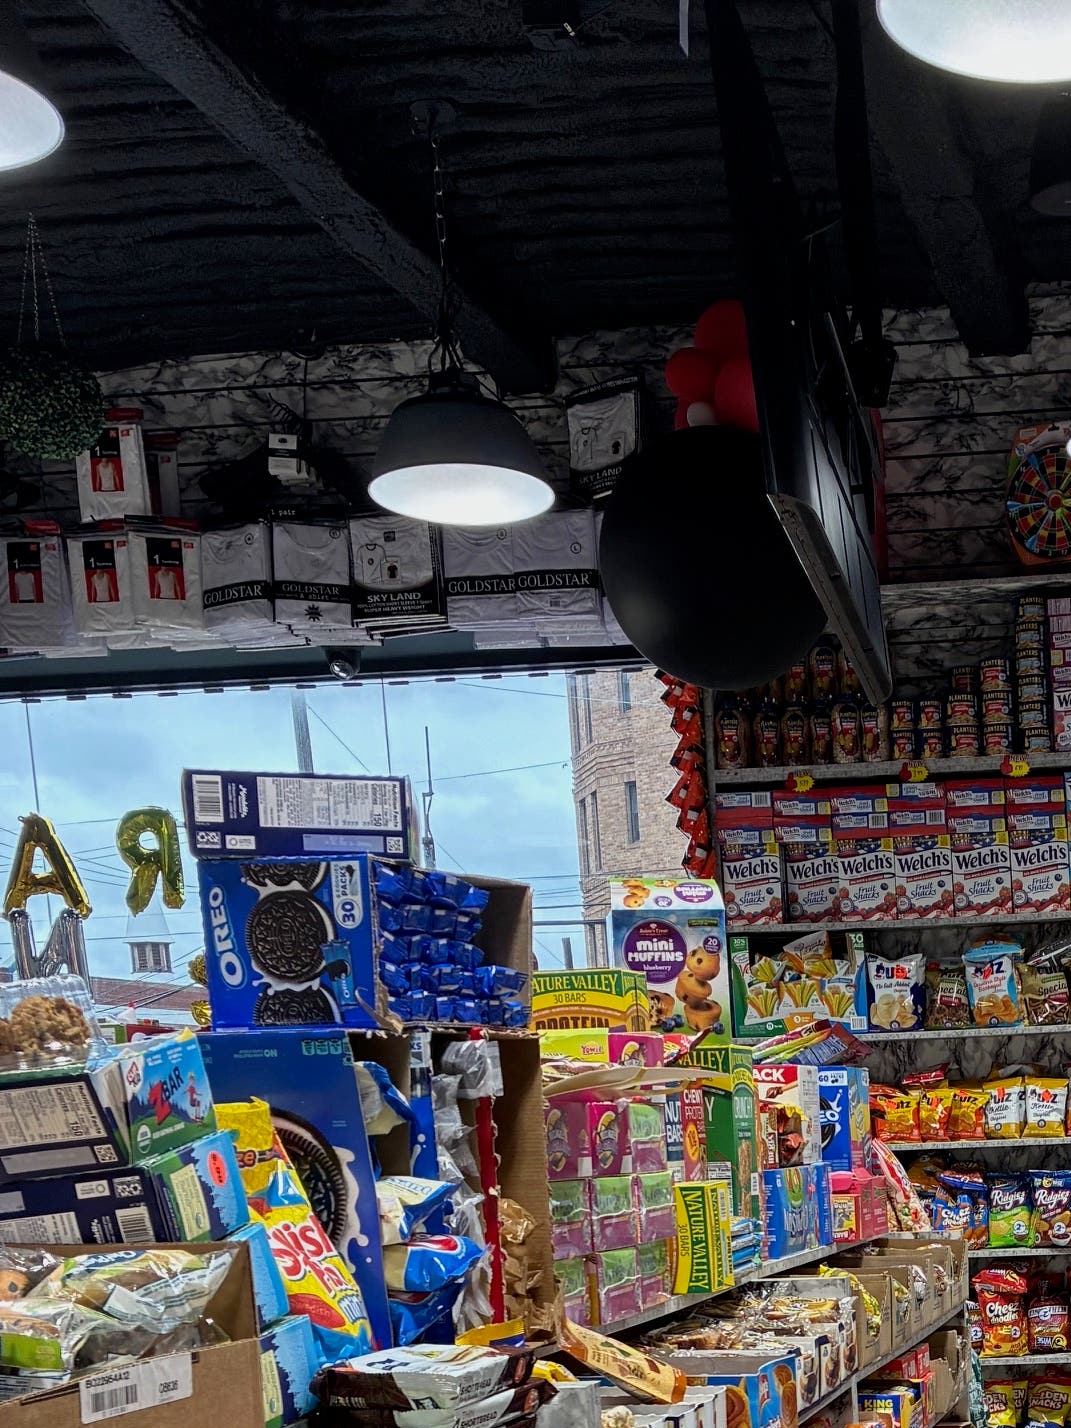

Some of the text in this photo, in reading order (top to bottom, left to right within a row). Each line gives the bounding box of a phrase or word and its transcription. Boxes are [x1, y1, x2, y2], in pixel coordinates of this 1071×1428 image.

[449, 578, 515, 593] GOLDSTAR
[518, 572, 590, 588] GOLDSTAR
[204, 585, 262, 605] GOLDSTAR
[282, 583, 339, 596] GOLDSTAR
[367, 592, 421, 603] SKY LAND
[953, 726, 978, 735] PLANTERS
[897, 850, 950, 873] Welch's
[955, 848, 1008, 871] Welch's
[1014, 844, 1067, 868] Welch's
[726, 859, 778, 880] Welch's
[839, 854, 893, 876] Welch's
[915, 882, 933, 893] Fruit
[973, 878, 991, 889] Fruit
[744, 888, 762, 899] Fruit
[807, 888, 825, 899] Fruit
[853, 892, 880, 902] Snacks
[858, 885, 876, 896] Fruit
[910, 889, 937, 900] Snacks
[968, 885, 995, 896] Snacks
[740, 896, 766, 906] Snacks
[802, 896, 828, 906] Snacks
[342, 901, 355, 923] 30
[209, 886, 243, 987] OREO
[636, 938, 674, 951] mini
[628, 951, 684, 962] MUFFINS
[572, 974, 618, 991] VALLEY
[554, 993, 586, 1003] 30 BARS
[162, 1066, 184, 1100] BAR
[1036, 1189, 1070, 1204] Ridgies
[683, 1190, 704, 1290] NATURE VALLEY
[987, 1302, 1019, 1317] Cheez
[991, 1311, 1019, 1323] doodles
[864, 1399, 893, 1408] KING
